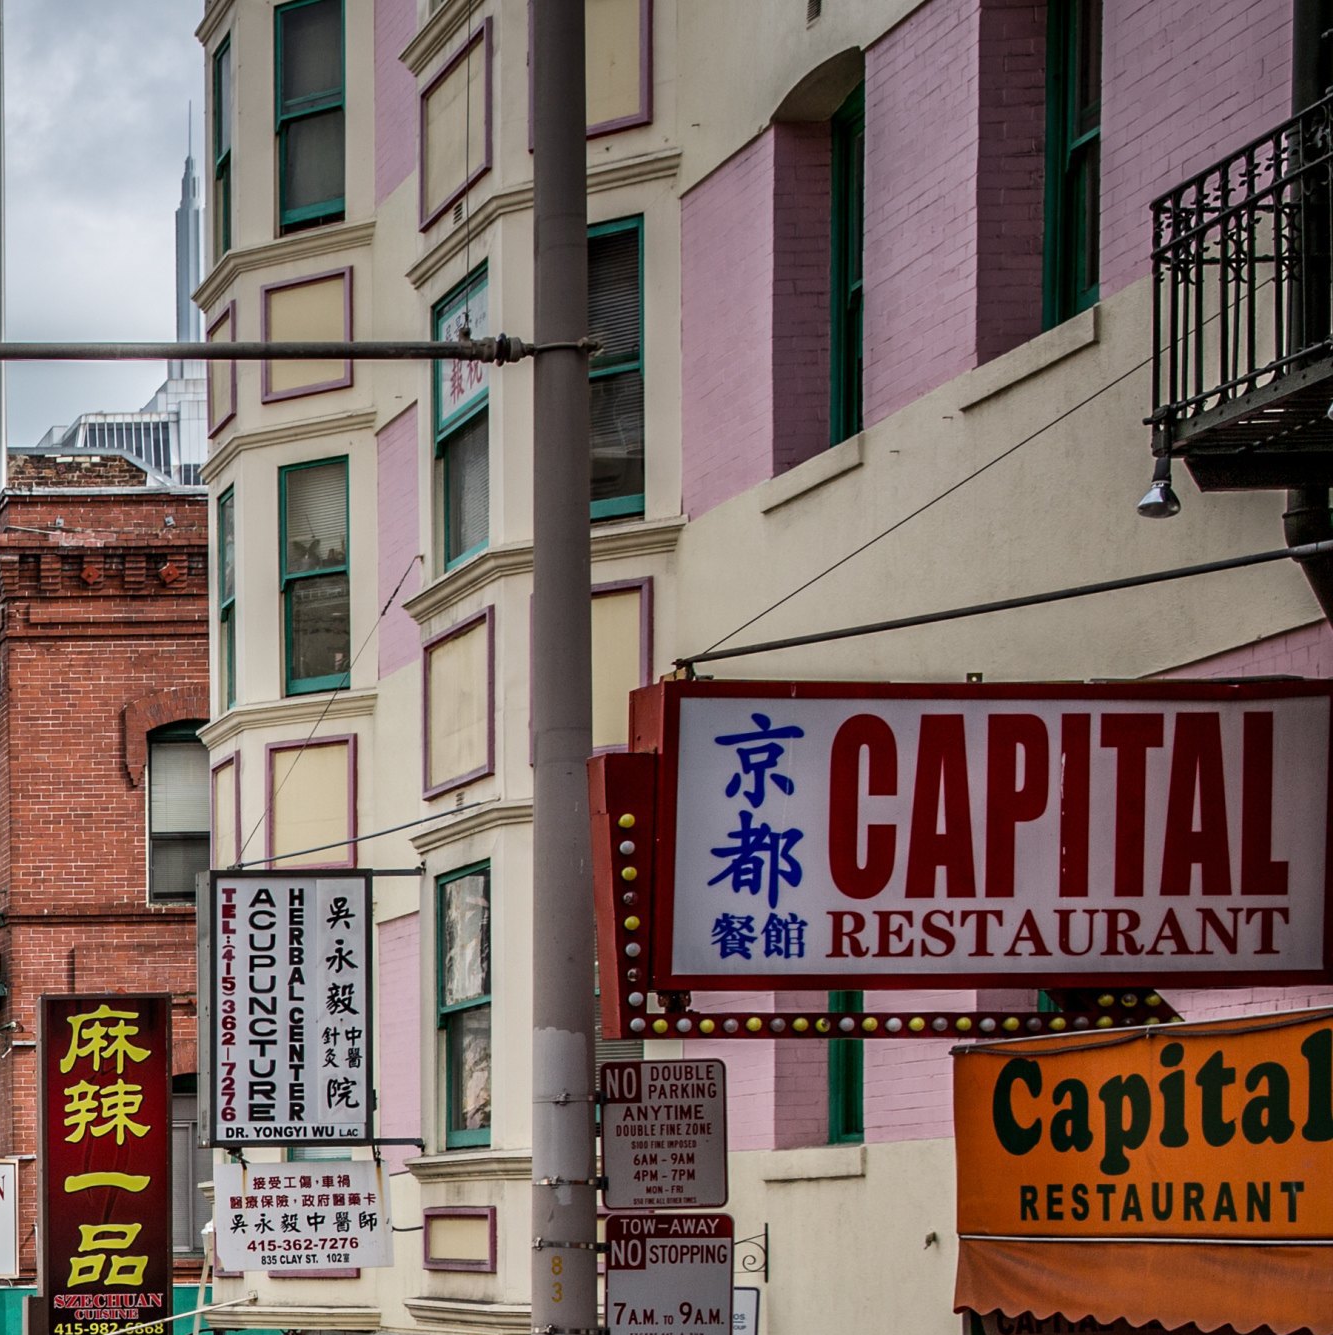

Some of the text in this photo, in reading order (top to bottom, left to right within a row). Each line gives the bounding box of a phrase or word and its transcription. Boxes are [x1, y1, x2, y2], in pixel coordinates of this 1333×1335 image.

[828, 711, 1289, 900] CAPITAL
[826, 907, 1290, 959] RESTAURANT
[248, 888, 277, 1122] ACUPUNCTURE
[287, 888, 305, 1121] HERBAL CENTER
[606, 1065, 715, 1099] NO DOUBLE
[648, 1082, 717, 1099] PARKING
[993, 1029, 1333, 1177] Capital
[623, 1104, 704, 1121] ANYTIME
[225, 1126, 334, 1139] DR. YONGYI WU
[616, 1123, 712, 1137] DOUBLE FINE ZONE
[60, 1005, 151, 1287] 麻辣一品
[633, 1153, 695, 1165] 6AM 9AM
[633, 1169, 695, 1181] 4PM 7PM
[1020, 1181, 1305, 1225] RESTAURANT
[620, 1218, 719, 1234] TOW-AWAY
[247, 1237, 359, 1252] 415-362-7276
[611, 1239, 727, 1266] NO STOPPING
[261, 1255, 277, 1265] 835
[279, 1254, 302, 1264] CLAY
[305, 1254, 319, 1263] ST.
[54, 1293, 163, 1309] SZECHUAN
[74, 1309, 139, 1320] CUISINE
[663, 1315, 674, 1325] TO
